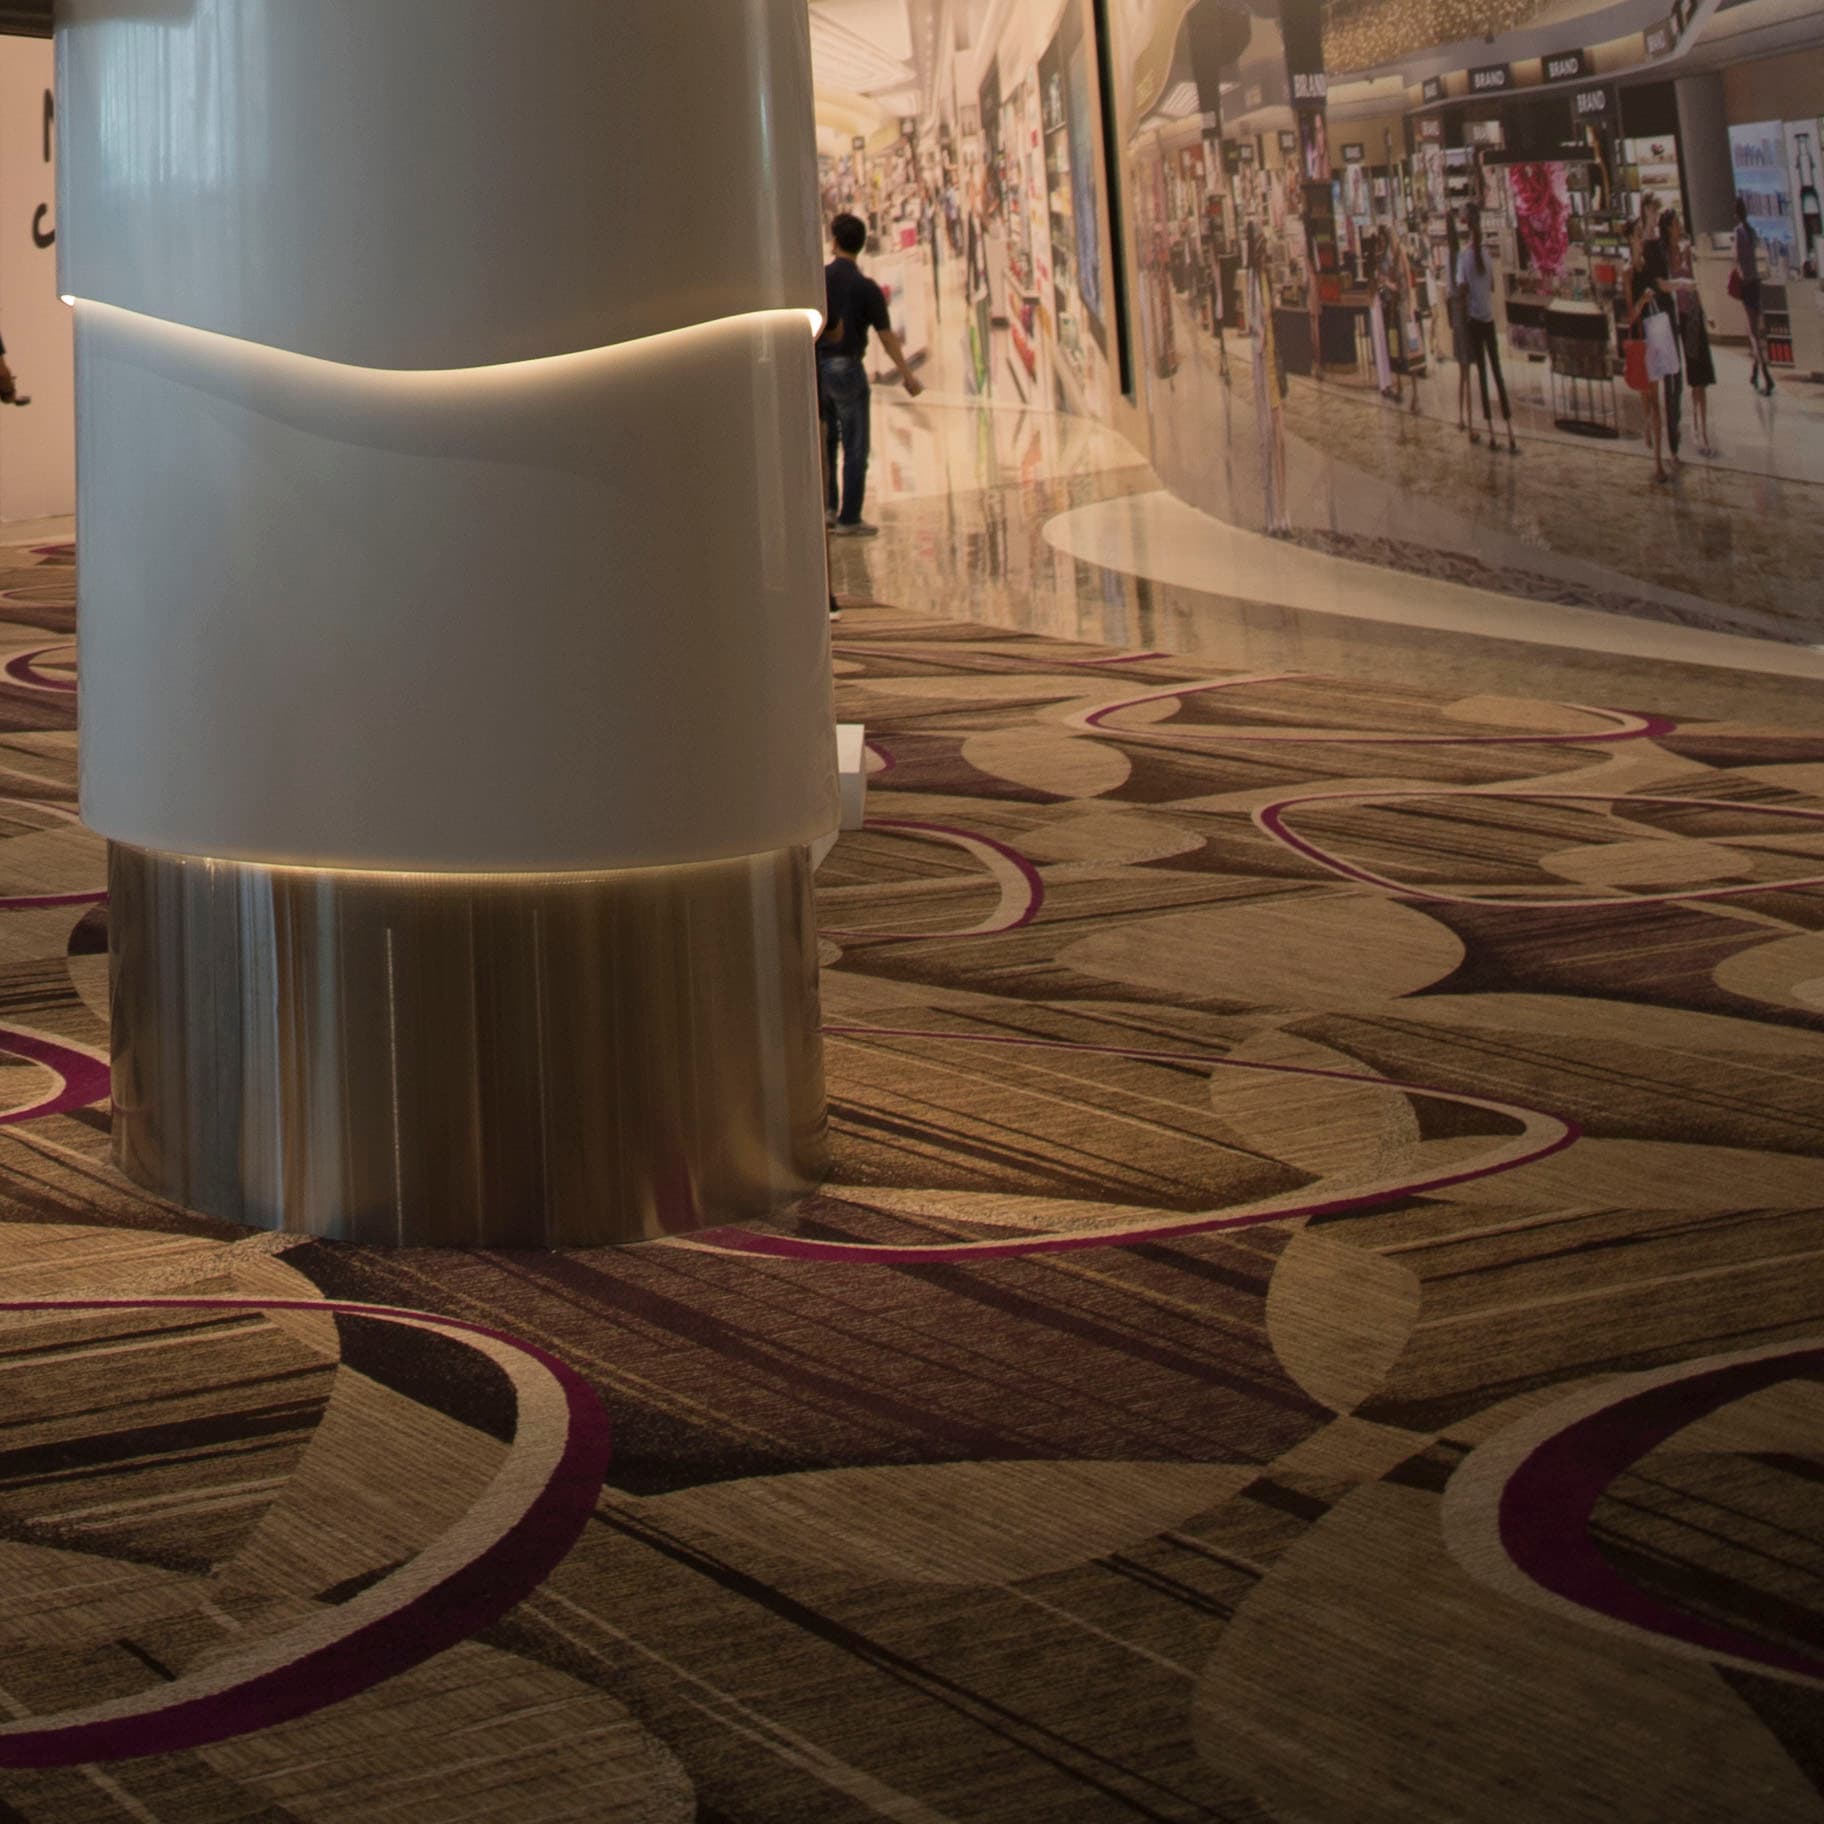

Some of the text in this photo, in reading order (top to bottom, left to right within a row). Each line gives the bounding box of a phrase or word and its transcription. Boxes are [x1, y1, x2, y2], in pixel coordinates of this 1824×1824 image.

[1474, 69, 1505, 88] BRAND
[1548, 57, 1578, 78] BRAND
[1293, 73, 1326, 99] BRAND
[1577, 89, 1606, 114] BRAND
